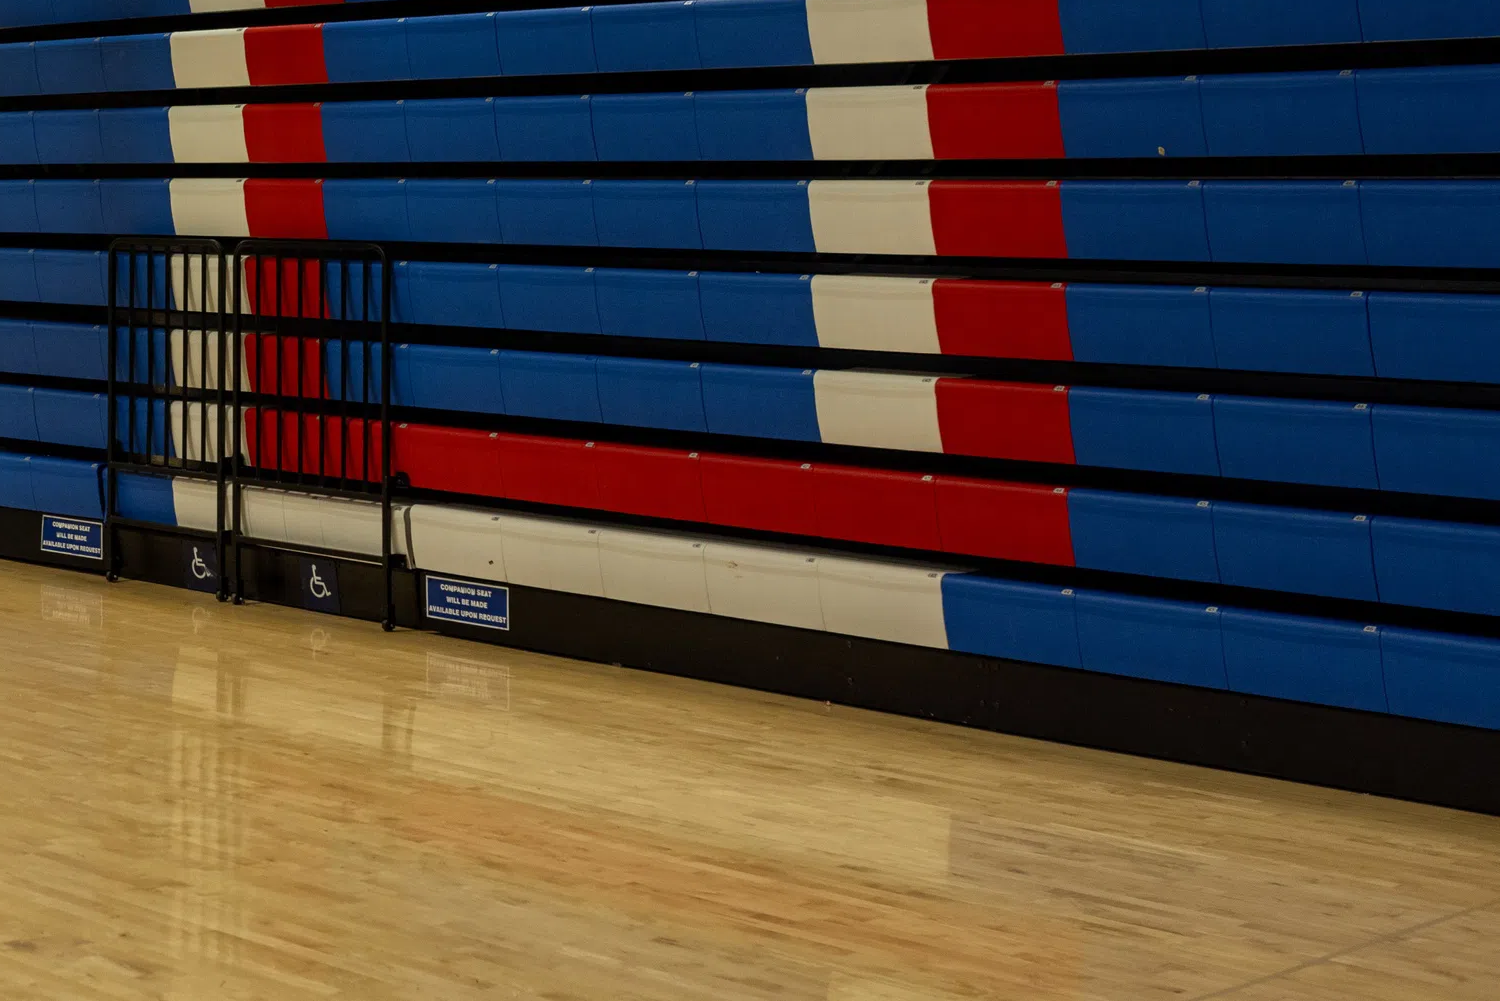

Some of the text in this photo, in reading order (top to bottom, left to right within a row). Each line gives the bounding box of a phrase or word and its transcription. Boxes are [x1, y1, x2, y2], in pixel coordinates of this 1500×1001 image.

[52, 521, 79, 531] COMPANION
[56, 531, 67, 539] WILL
[74, 534, 87, 542] MADE
[66, 543, 79, 551] UPON
[80, 545, 101, 554] REQUEST
[440, 583, 492, 598] COMPANION SEAT
[445, 596, 488, 609] WILL BE MADE
[429, 605, 507, 624] AVAILABLE UPON REQUEST
